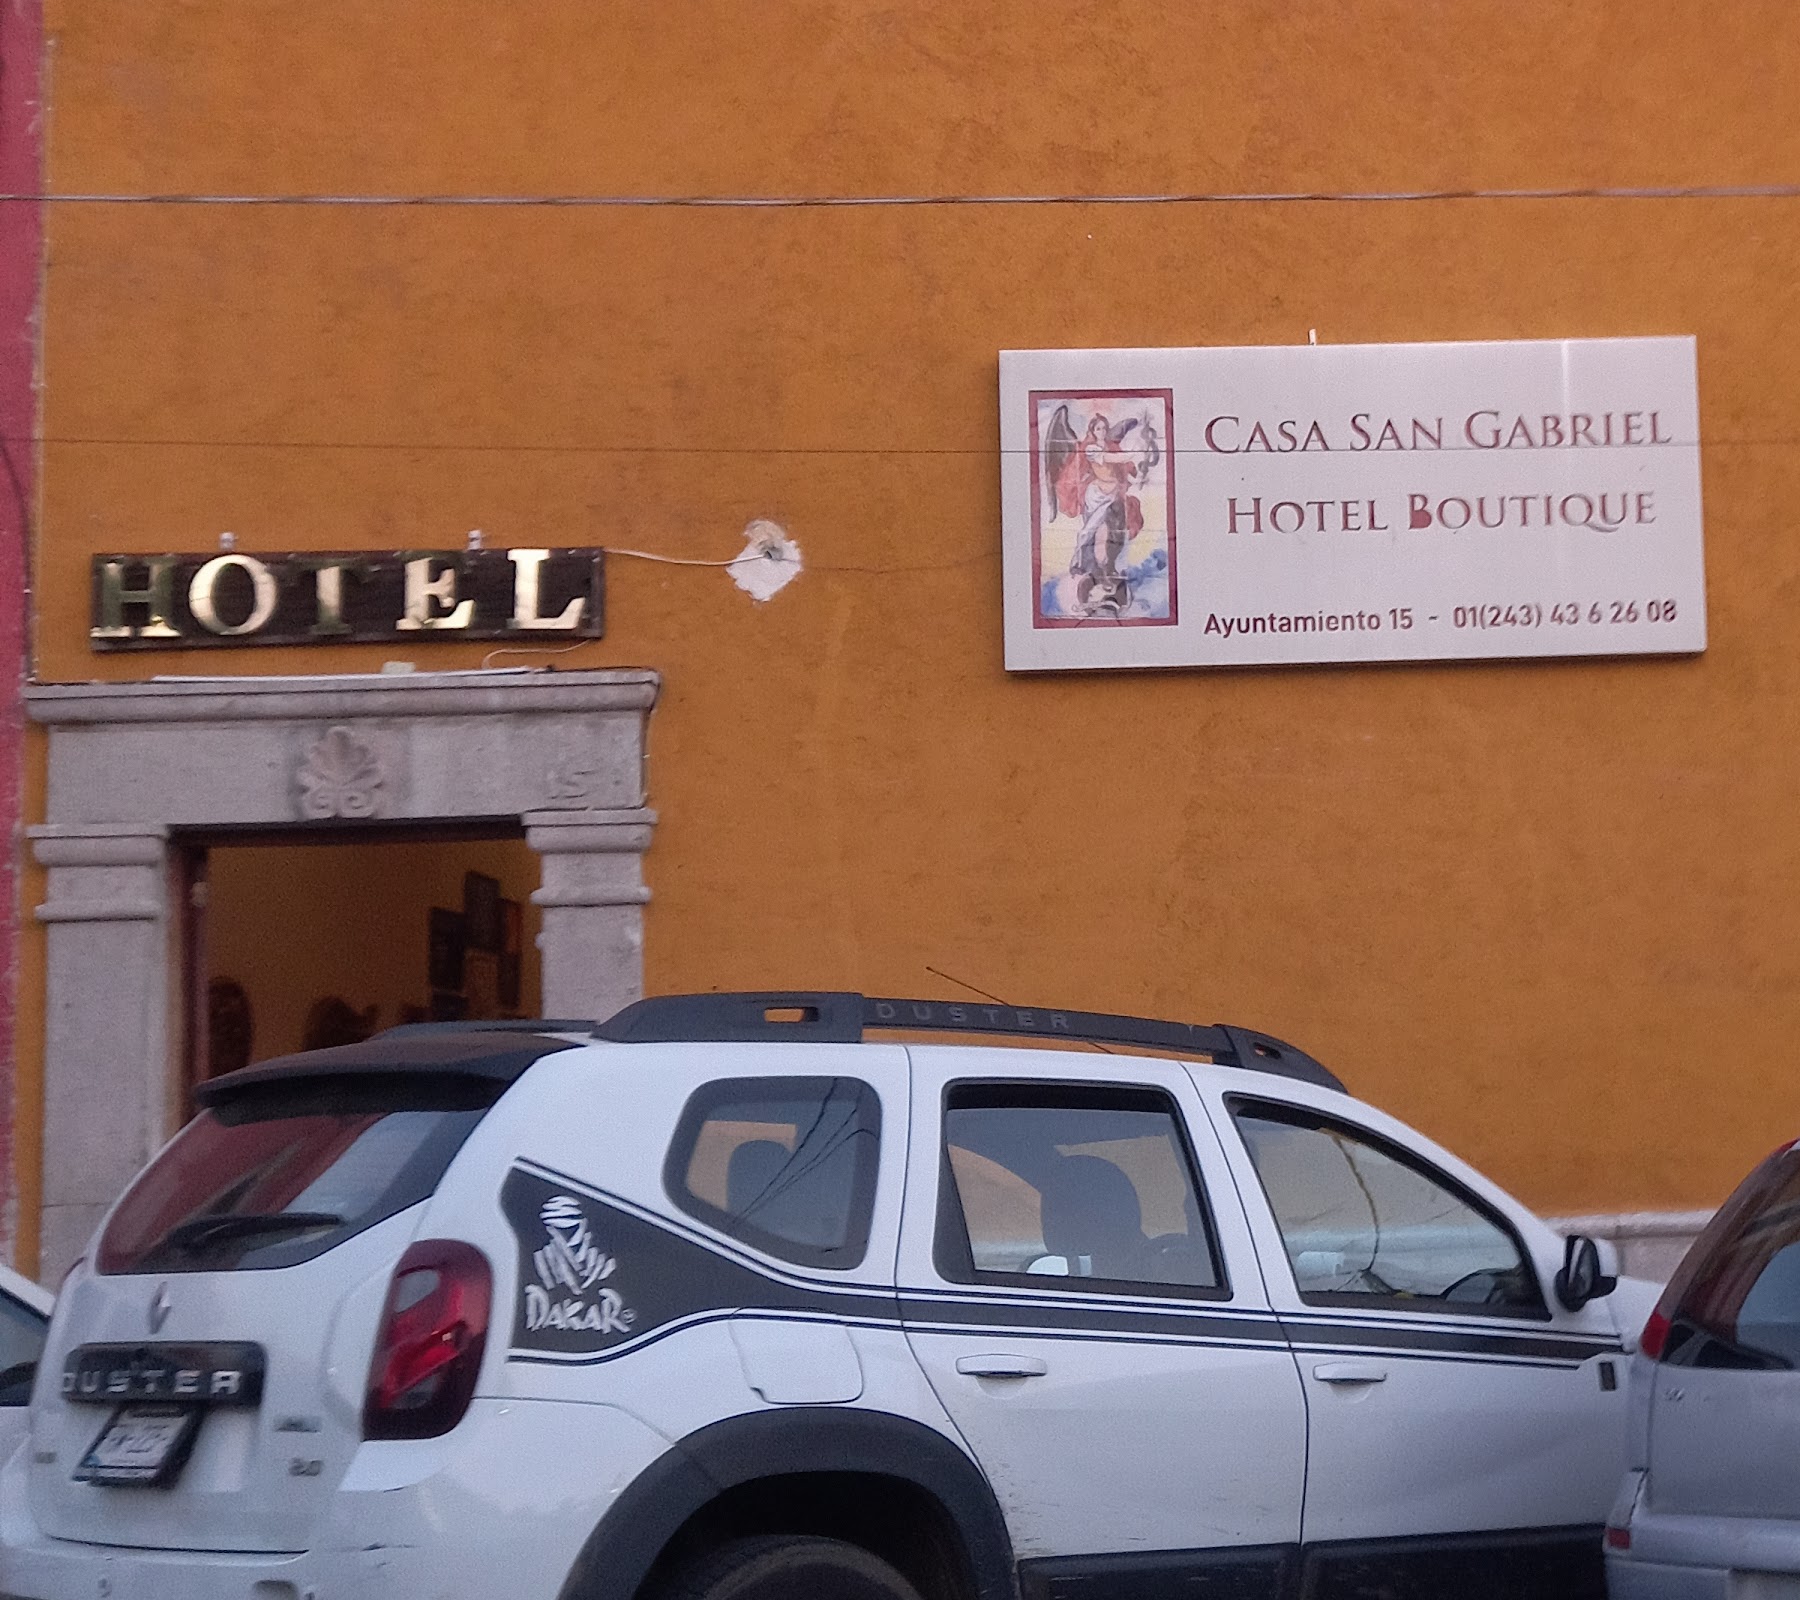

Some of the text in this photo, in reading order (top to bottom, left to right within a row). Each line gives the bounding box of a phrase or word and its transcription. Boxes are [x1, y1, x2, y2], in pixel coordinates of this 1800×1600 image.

[1204, 410, 1672, 453] CASA SAN GABRIEL
[1227, 490, 1657, 534] HOTEL BOUTIQUE
[89, 548, 586, 640] HOTEL
[1203, 610, 1381, 639] Ayuntamiento
[1388, 607, 1414, 630] 15
[1453, 603, 1543, 630] 01(243)
[1550, 602, 1580, 626] 43
[1587, 601, 1602, 625] 6
[1609, 600, 1639, 624] 26
[1647, 599, 1678, 624] 08
[876, 1002, 1069, 1030] DUSTER
[524, 1283, 631, 1334] DAKAR
[62, 1368, 242, 1395] DUSTER
